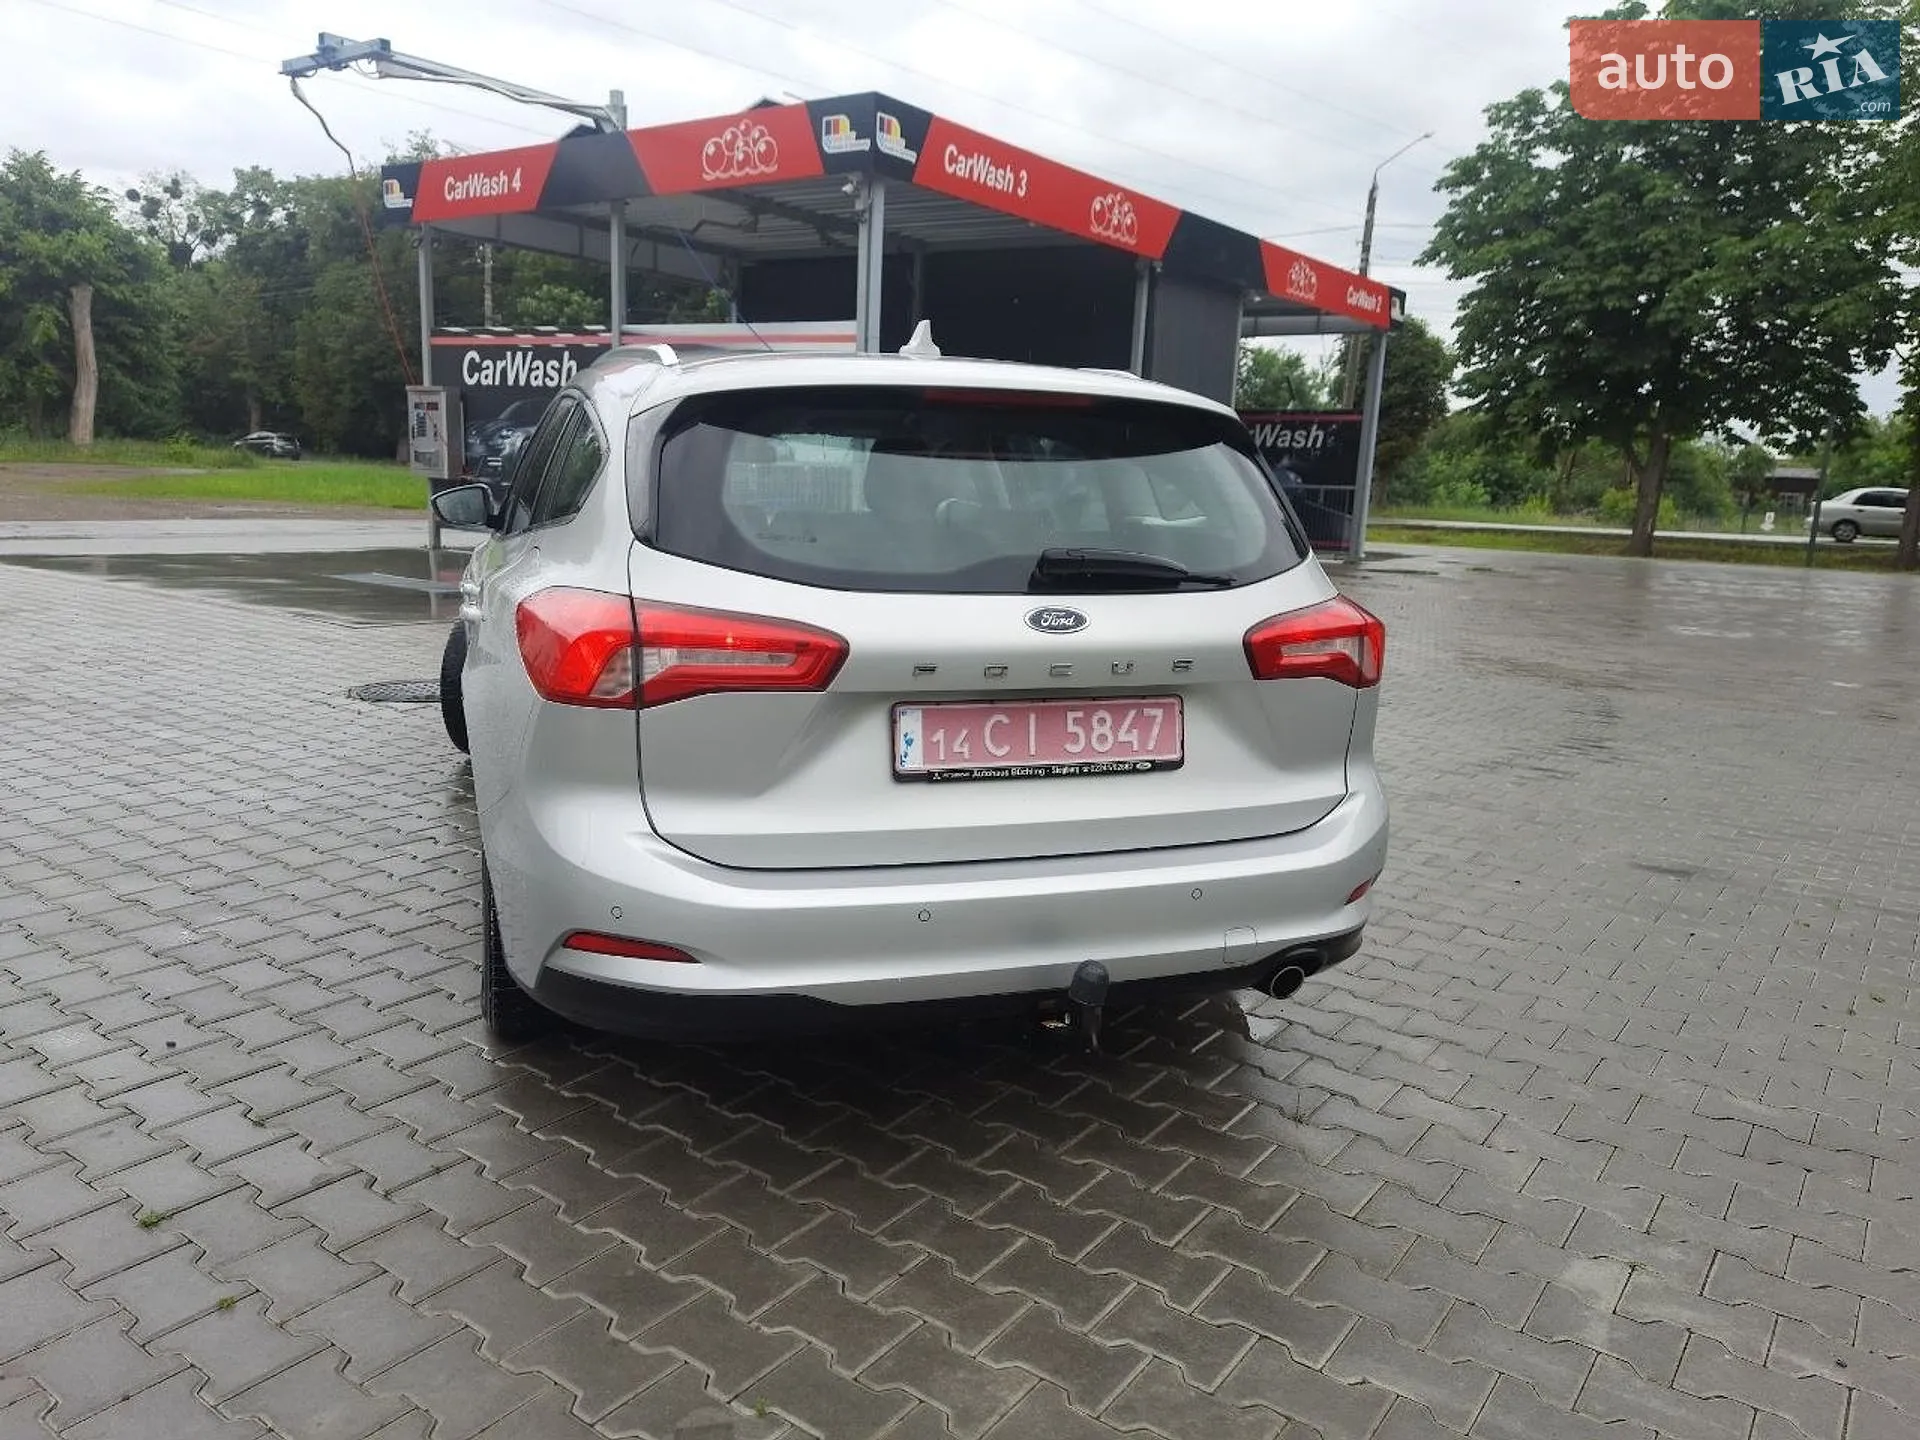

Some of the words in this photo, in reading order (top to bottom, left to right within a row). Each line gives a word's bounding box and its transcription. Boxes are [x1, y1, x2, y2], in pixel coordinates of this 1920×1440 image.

[444, 169, 509, 201] CarWash
[511, 167, 522, 192] 4
[944, 143, 1014, 194] CarWash
[1017, 169, 1028, 198] 3
[1347, 284, 1377, 312] CarWash
[1376, 295, 1383, 313] 2
[463, 350, 578, 387] CarWash
[1040, 611, 1075, 626] Ford
[912, 658, 1195, 679] FOCUS
[930, 728, 972, 761] 14
[1063, 707, 1165, 754] 5847
